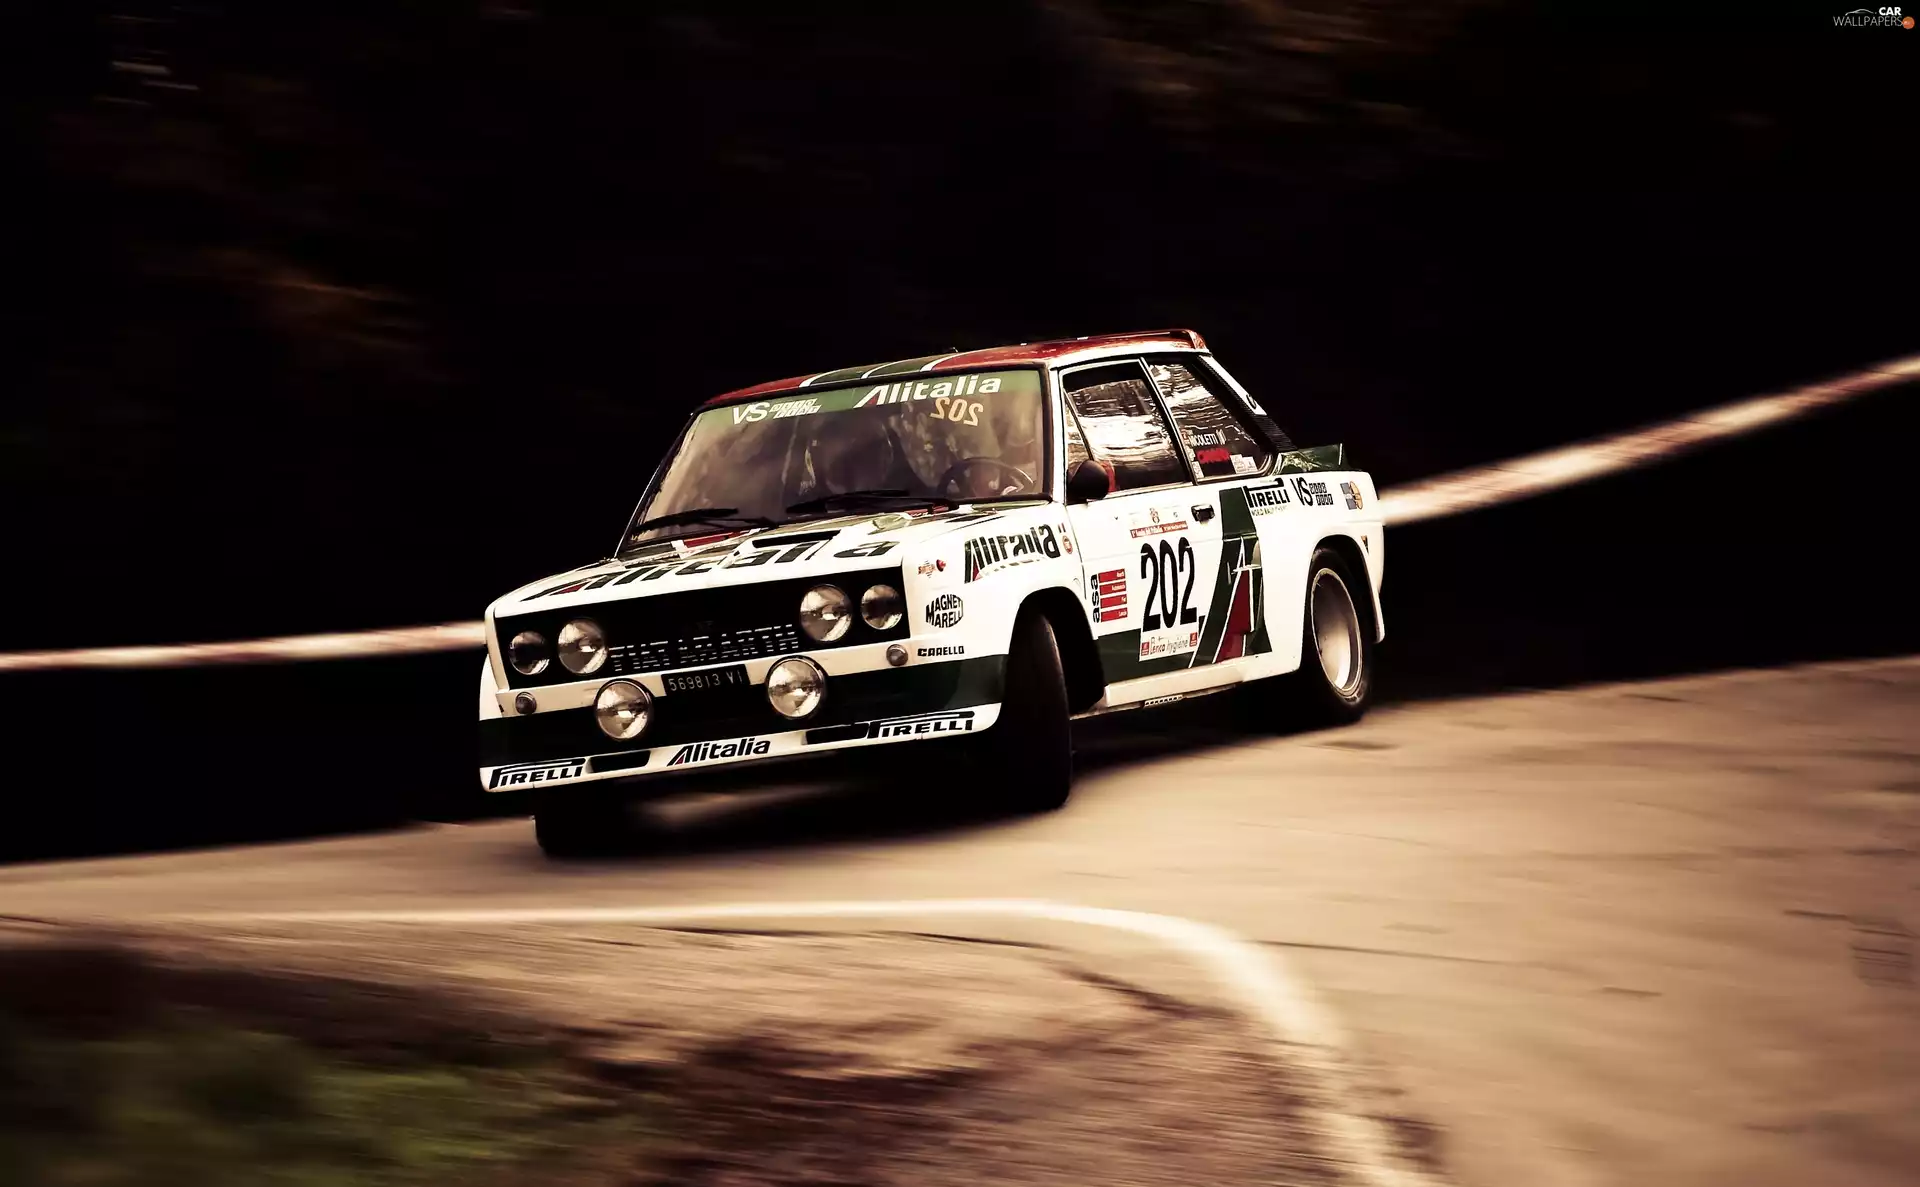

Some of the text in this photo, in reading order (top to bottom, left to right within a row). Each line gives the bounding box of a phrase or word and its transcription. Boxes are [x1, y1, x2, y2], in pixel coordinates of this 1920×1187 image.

[853, 375, 1002, 409] Alitalia
[733, 402, 770, 425] VS
[1243, 477, 1290, 508] PIRELLI
[1290, 477, 1313, 506] VS
[1140, 537, 1198, 632] 202
[916, 646, 965, 657] CARELLO
[668, 673, 720, 691] 569813
[867, 711, 975, 739] PIRELLI
[666, 737, 770, 766] Alitalia
[489, 758, 586, 790] PIRELLI
